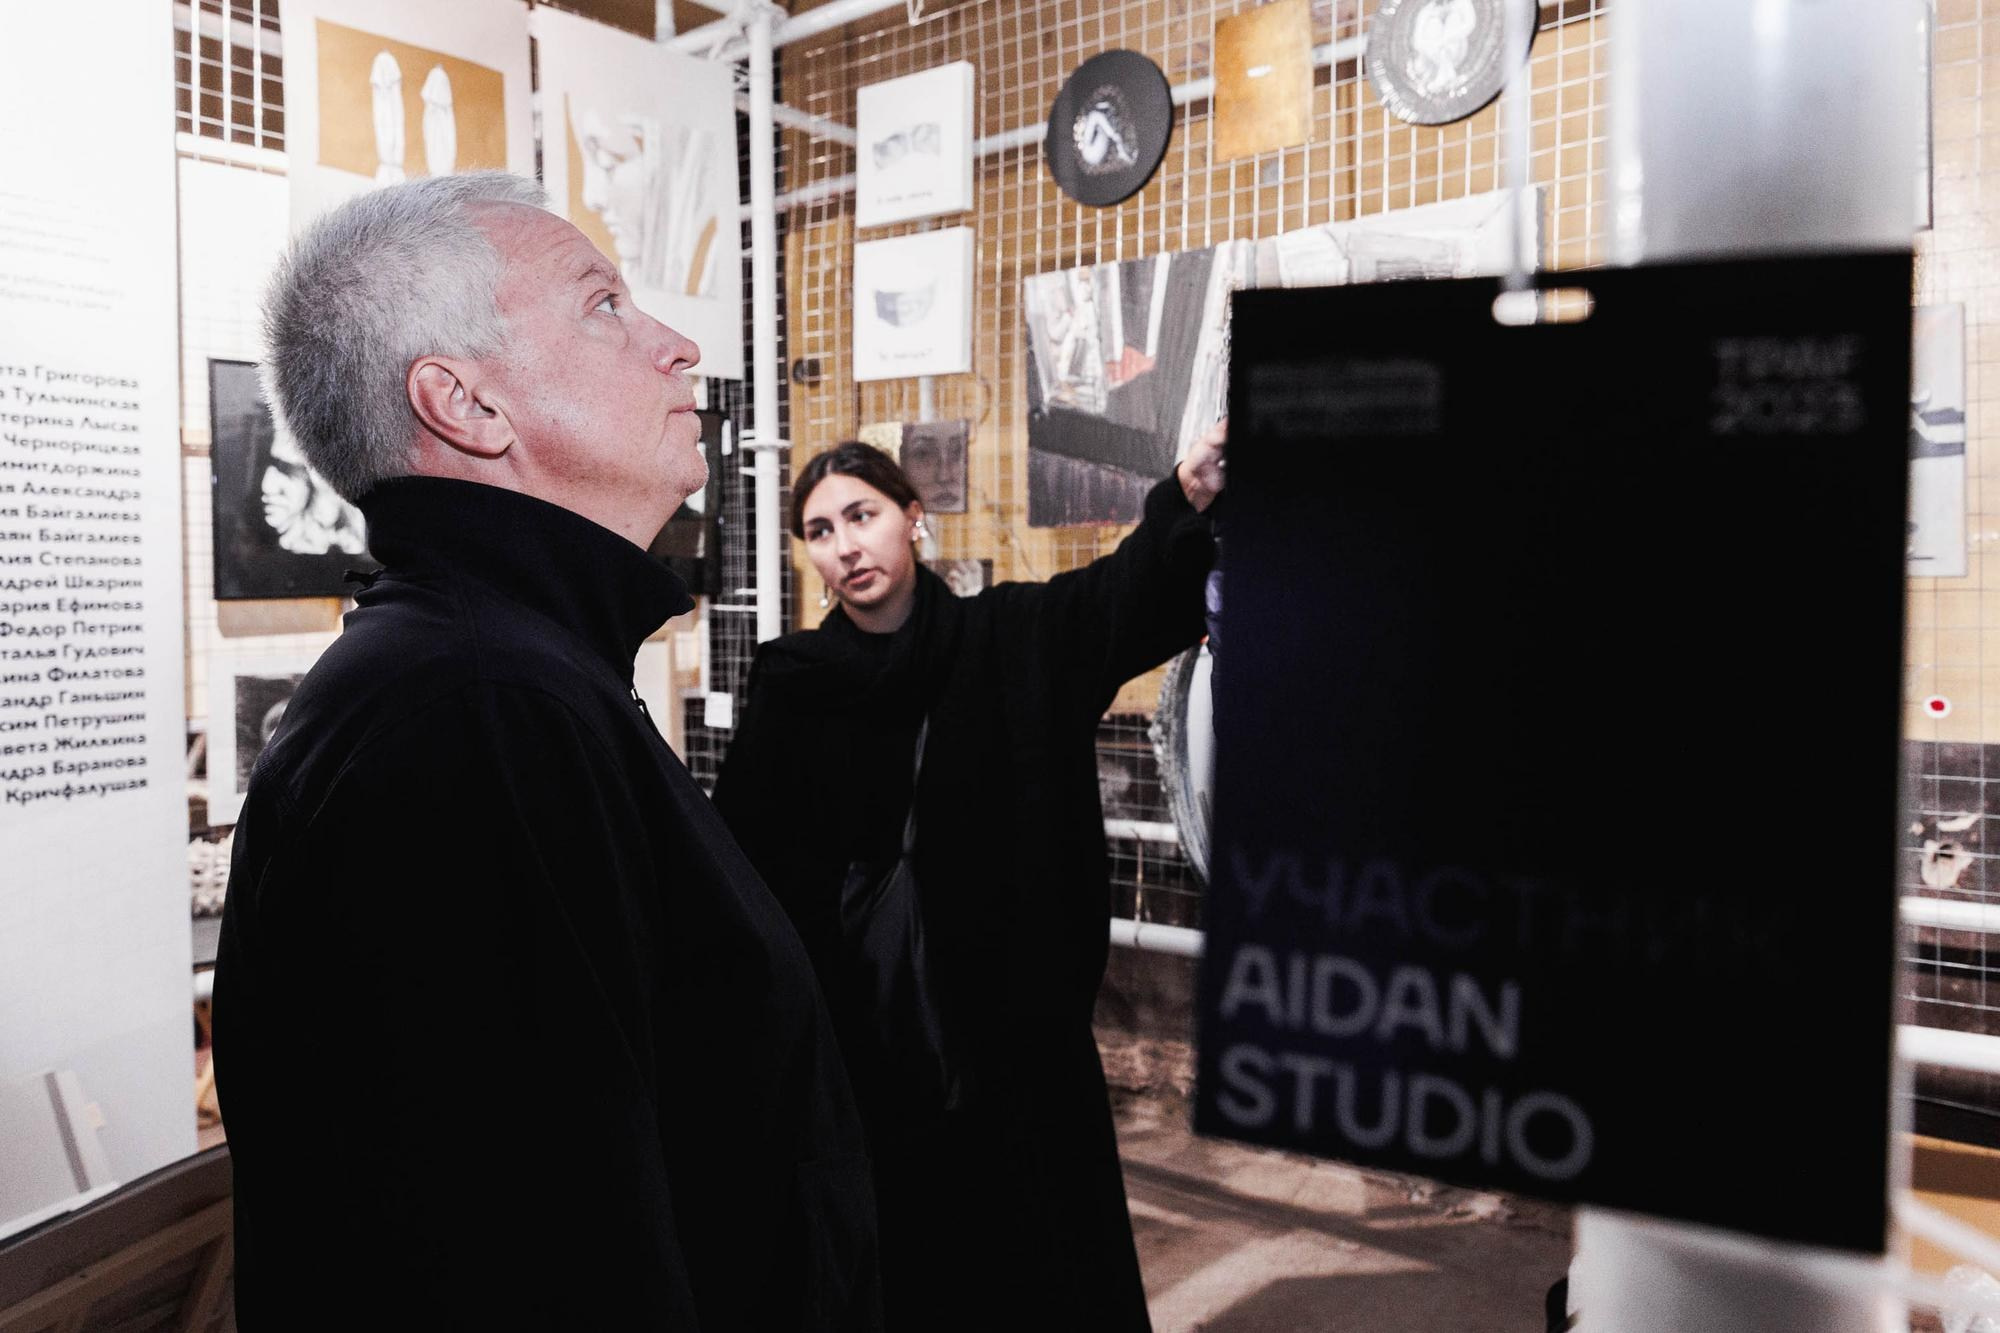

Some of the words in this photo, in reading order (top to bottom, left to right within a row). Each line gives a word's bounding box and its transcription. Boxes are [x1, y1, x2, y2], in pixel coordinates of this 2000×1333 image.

[34, 365, 138, 388] Григорова
[14, 387, 139, 410] Тульчинская
[81, 416, 138, 432] Лысая
[4, 432, 140, 454] Чернорицкая
[23, 482, 140, 501] Александра
[27, 504, 139, 521] Байгалиева
[40, 528, 141, 543] Байгалиев
[40, 551, 142, 566] Степанова
[65, 575, 142, 591] Шкарин
[57, 598, 143, 613] Ефимова
[73, 620, 143, 637] Петрик
[63, 644, 144, 662] Гудович
[47, 667, 144, 681] Филатова
[60, 690, 145, 704] Ганьшин
[45, 713, 145, 729] Петрушин
[55, 735, 146, 750] Жилкина
[53, 757, 147, 775] Баранова
[6, 779, 147, 804] Кричфалушая
[1219, 945, 1521, 1059] AIDAN
[1216, 1043, 1594, 1179] STUDIO
